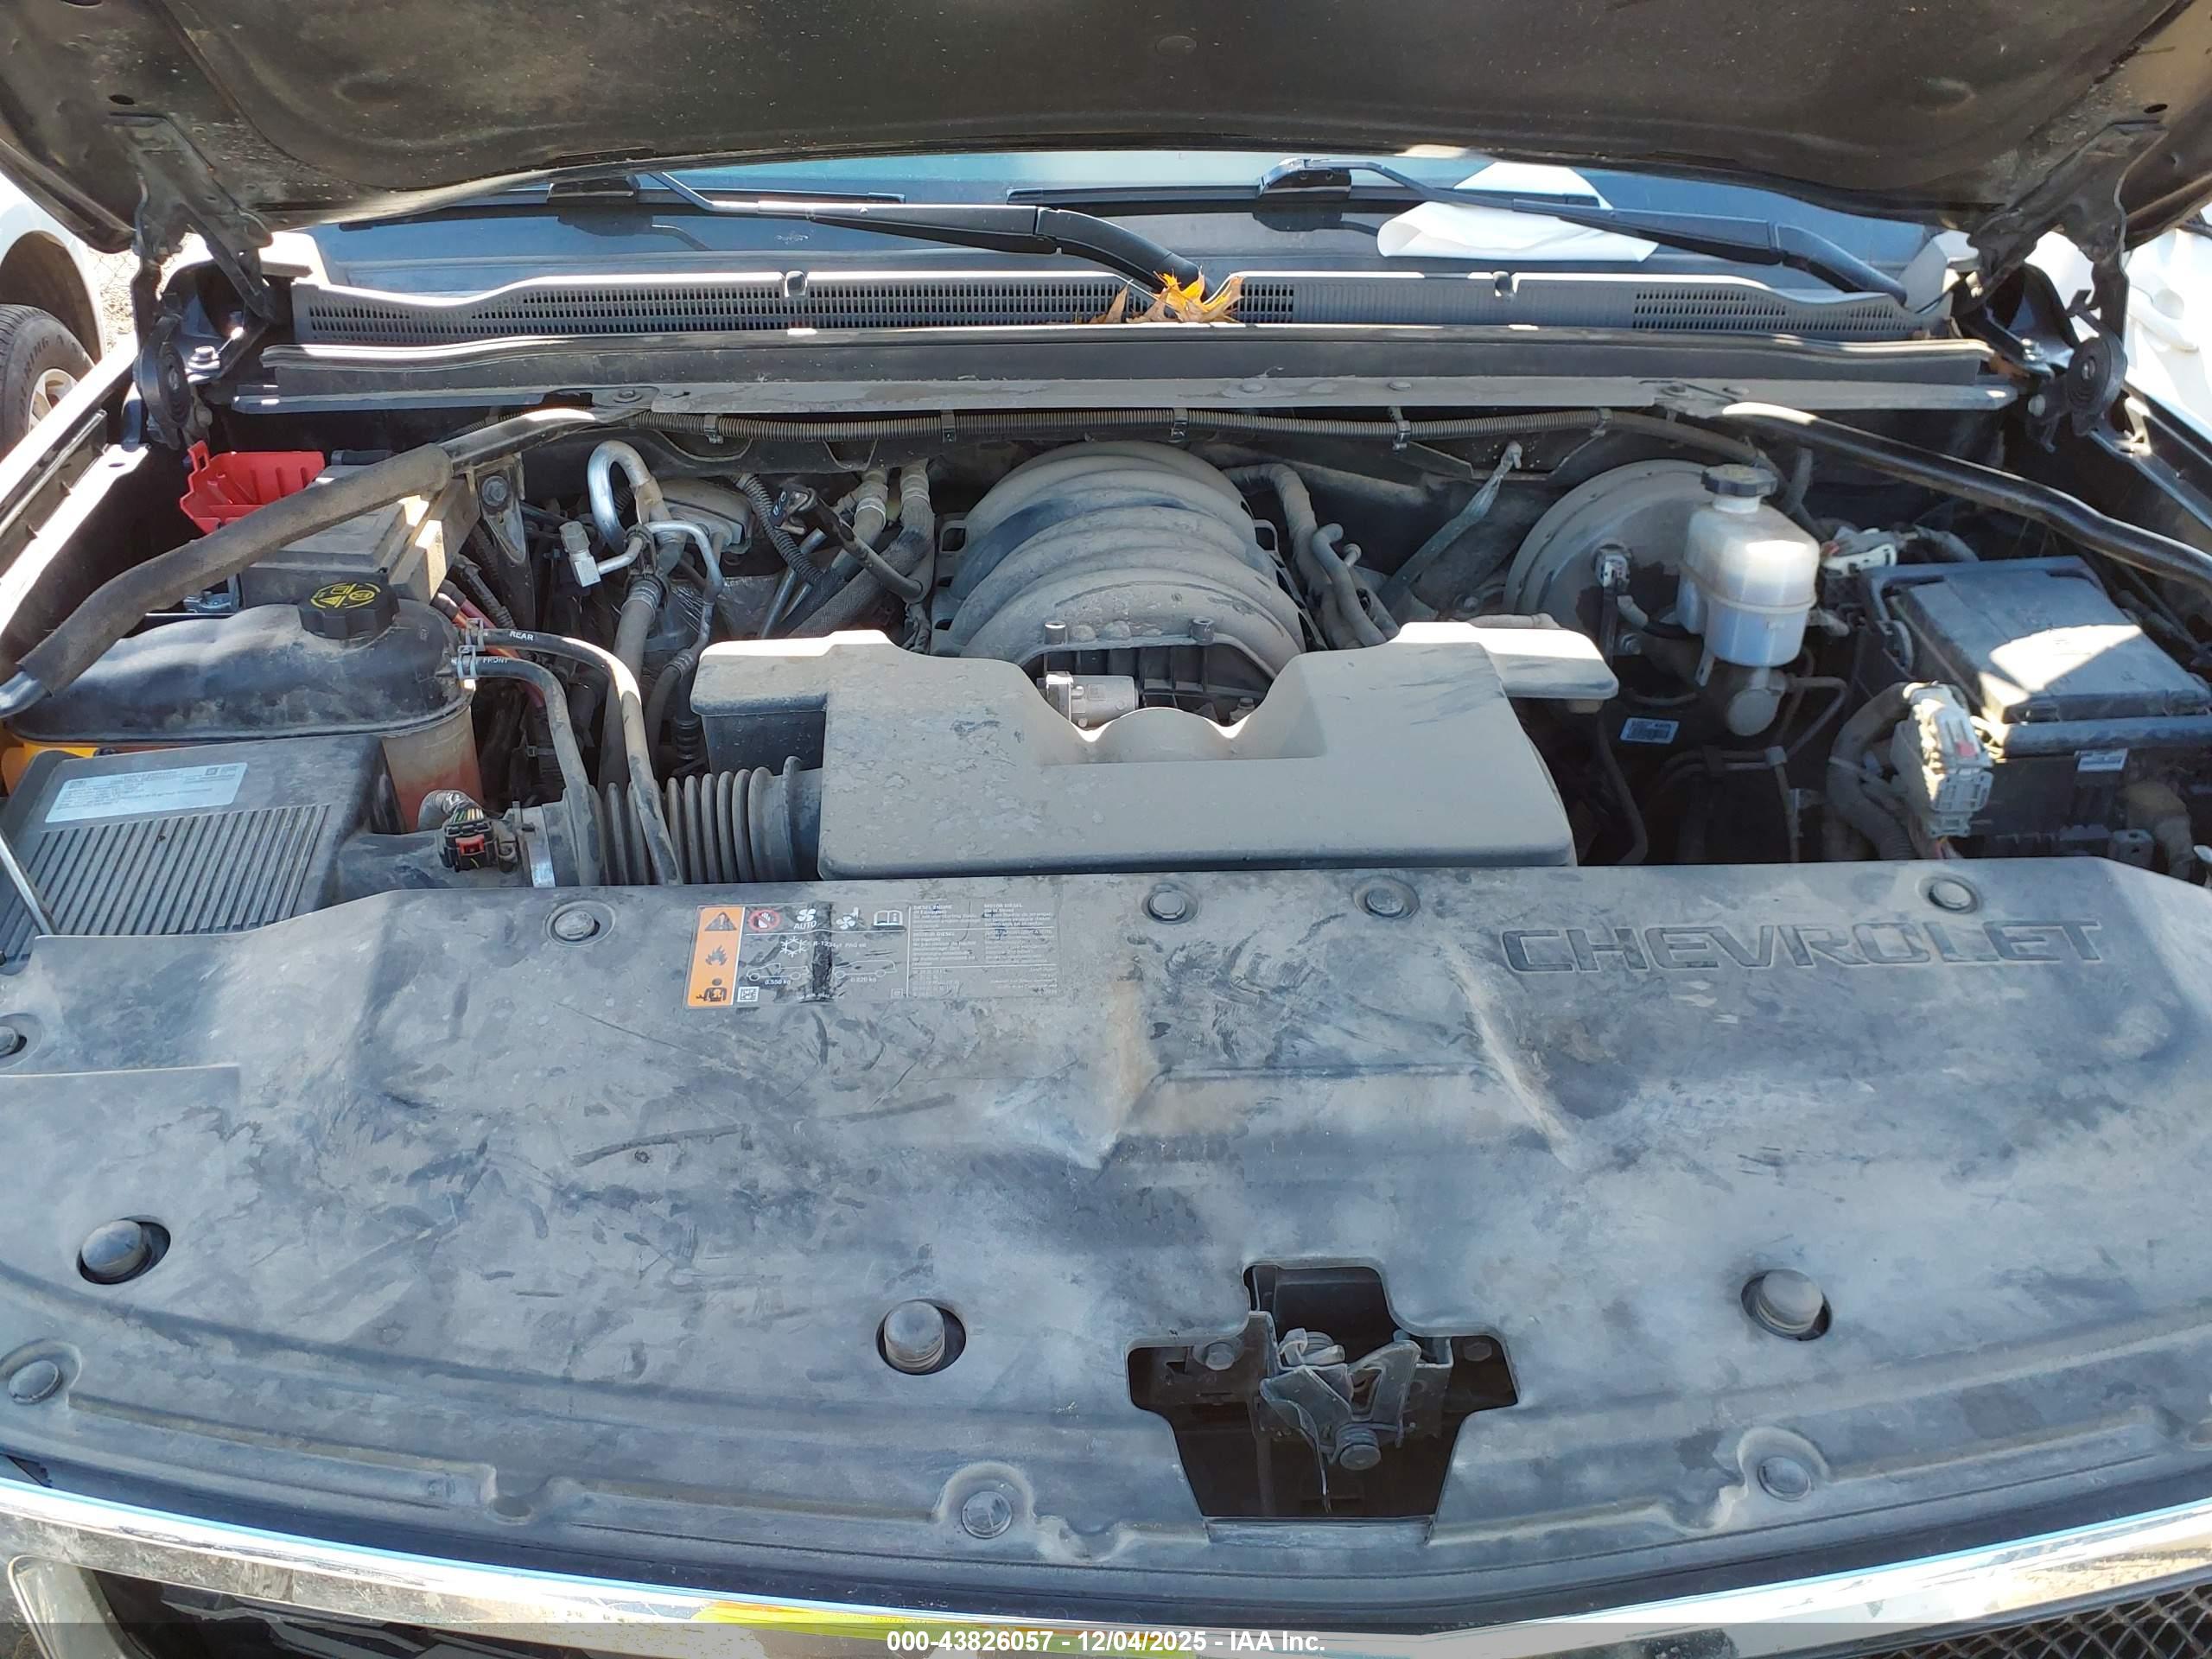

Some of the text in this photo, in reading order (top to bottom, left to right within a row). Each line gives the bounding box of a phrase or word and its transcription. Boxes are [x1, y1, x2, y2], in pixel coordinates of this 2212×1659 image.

[509, 630, 535, 641] REAR
[793, 920, 817, 931] AUTO
[1501, 918, 2105, 974] CHEVROLET
